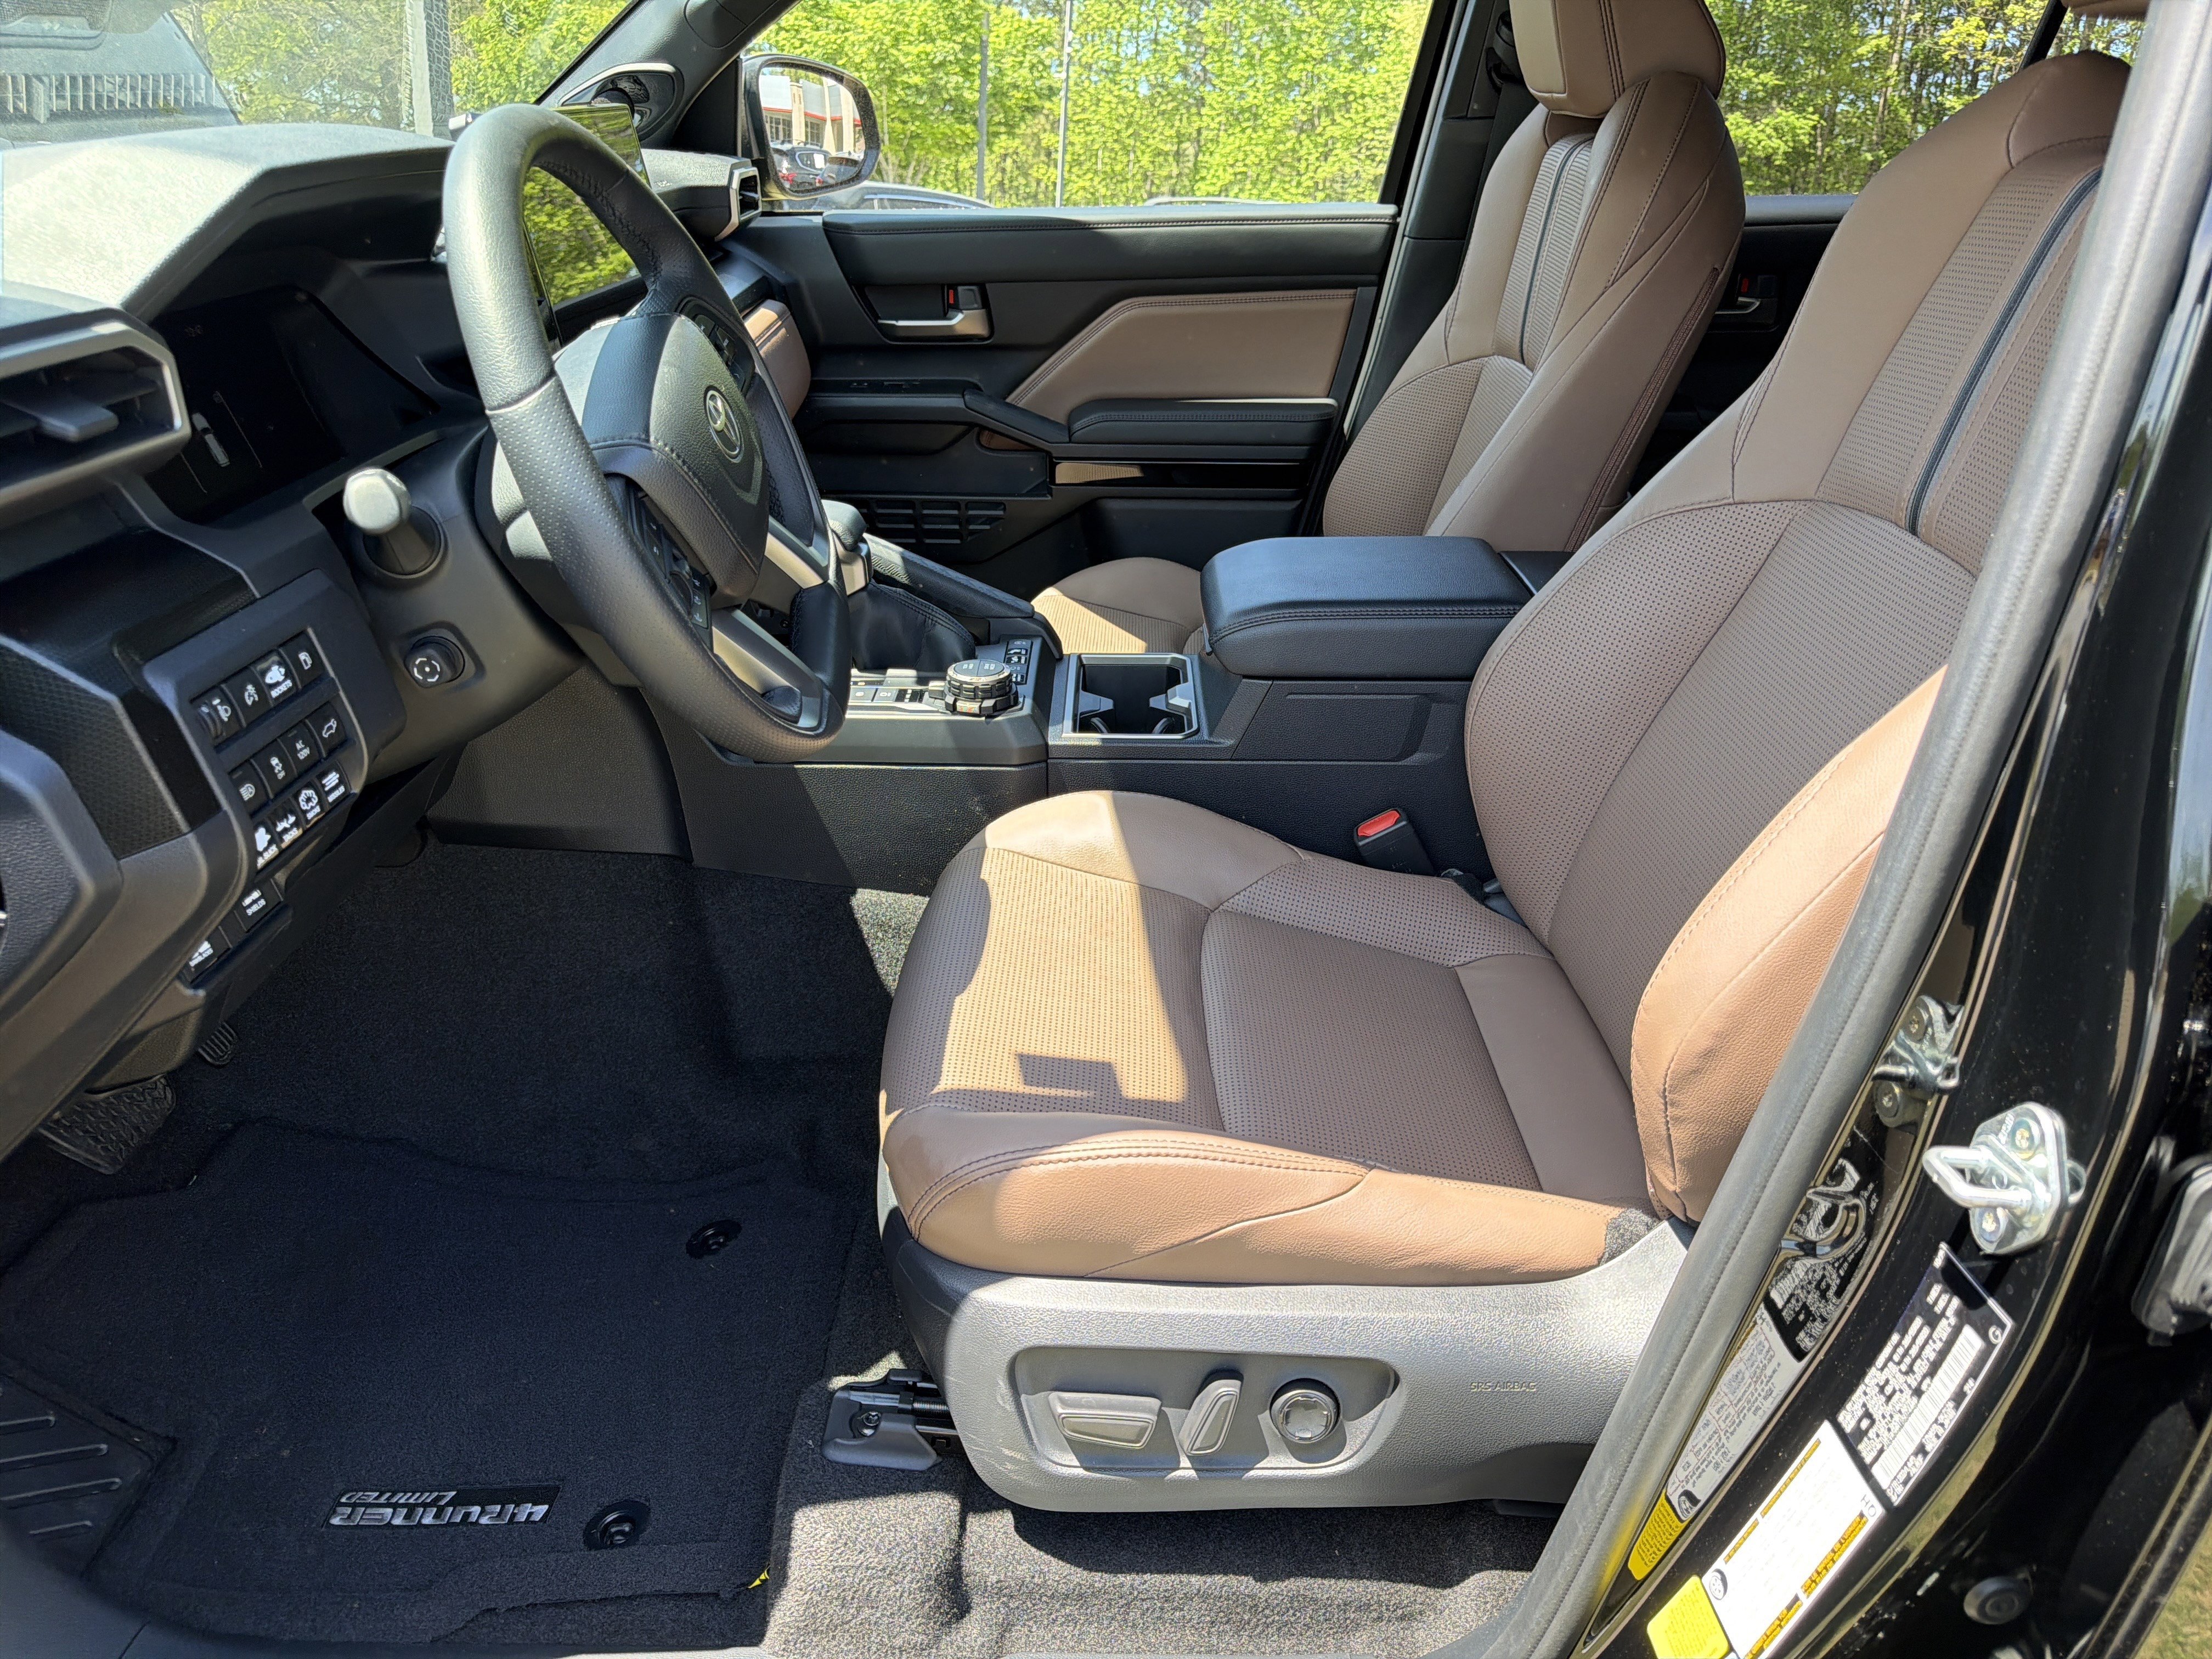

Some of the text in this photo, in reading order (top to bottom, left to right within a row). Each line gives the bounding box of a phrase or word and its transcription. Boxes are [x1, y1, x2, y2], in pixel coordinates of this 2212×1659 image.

[296, 740, 305, 751] AC
[246, 899, 266, 916] SHIELDS
[1470, 1381, 1536, 1392] SRS AIRBAG
[340, 1491, 458, 1503] LIMITED
[329, 1503, 549, 1526] 4RUNNER
